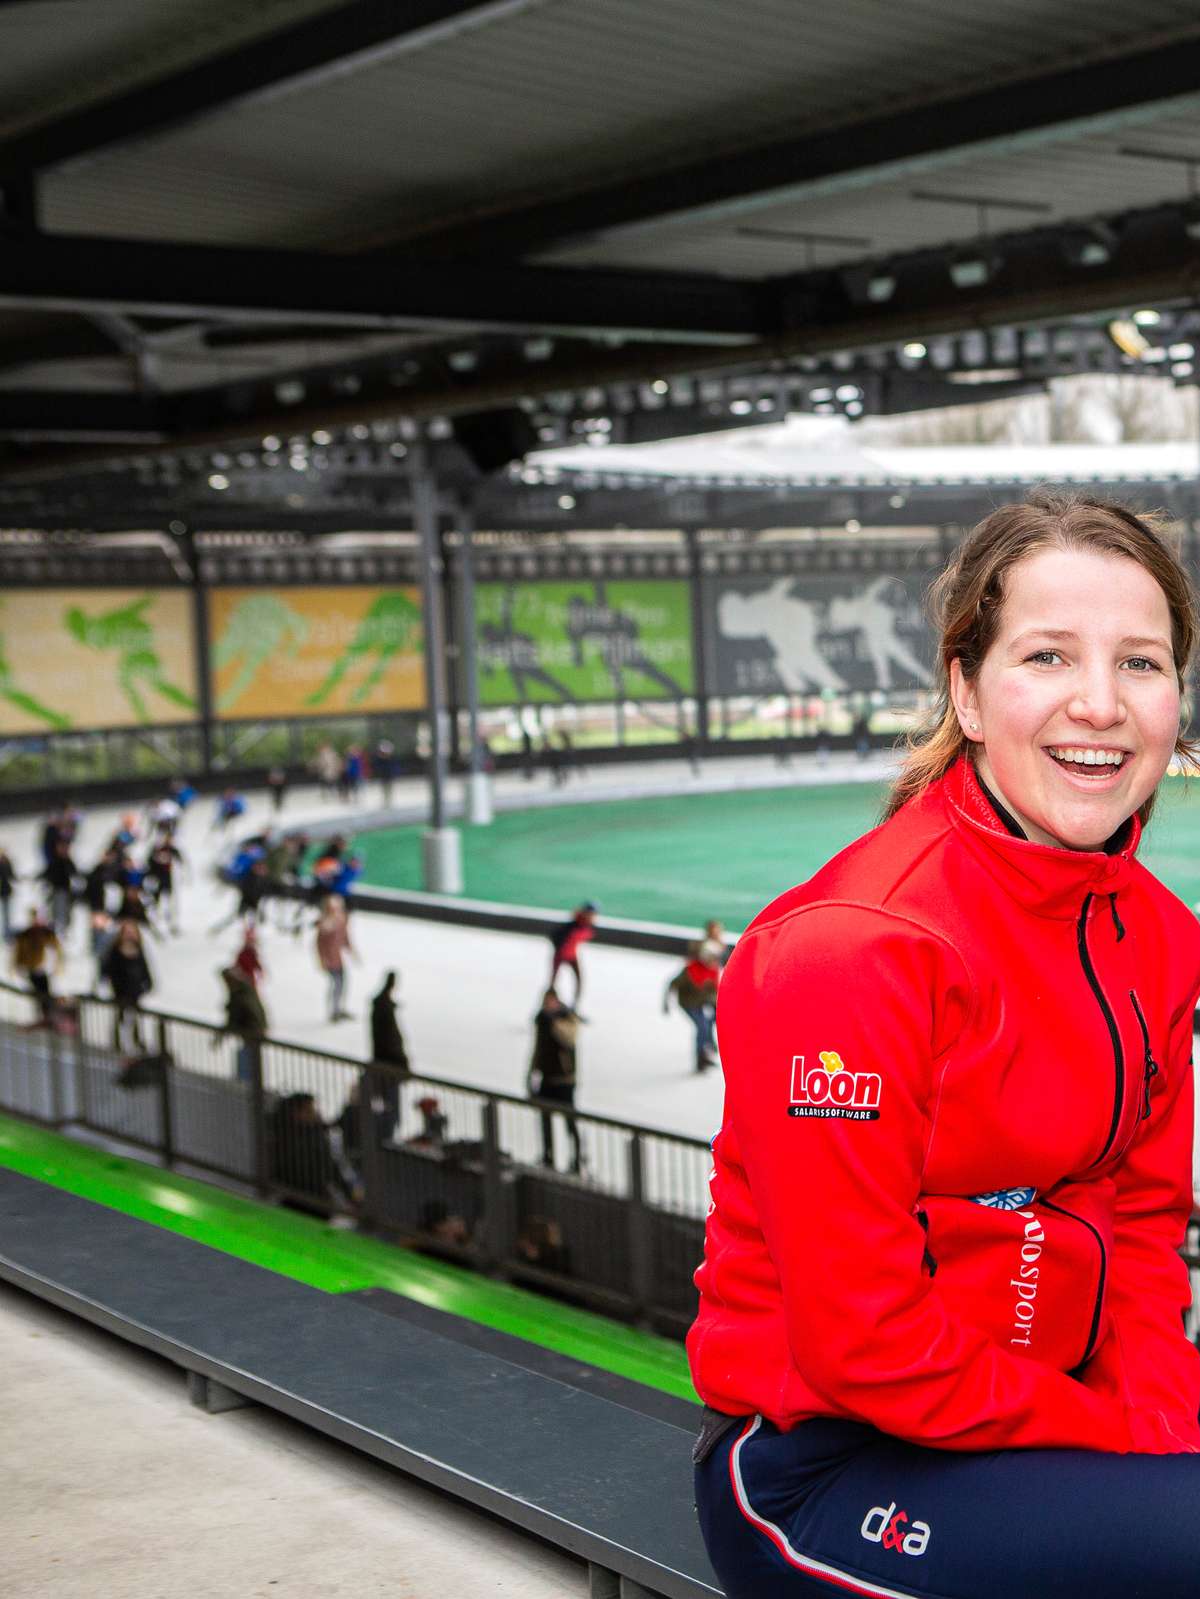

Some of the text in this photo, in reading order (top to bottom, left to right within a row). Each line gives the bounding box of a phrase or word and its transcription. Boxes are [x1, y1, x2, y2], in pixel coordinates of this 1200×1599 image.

[790, 1055, 882, 1107] Loon
[794, 1107, 871, 1119] SALARISSOFTWARE
[1010, 1210, 1046, 1348] uosport
[861, 1501, 931, 1556] d&a
